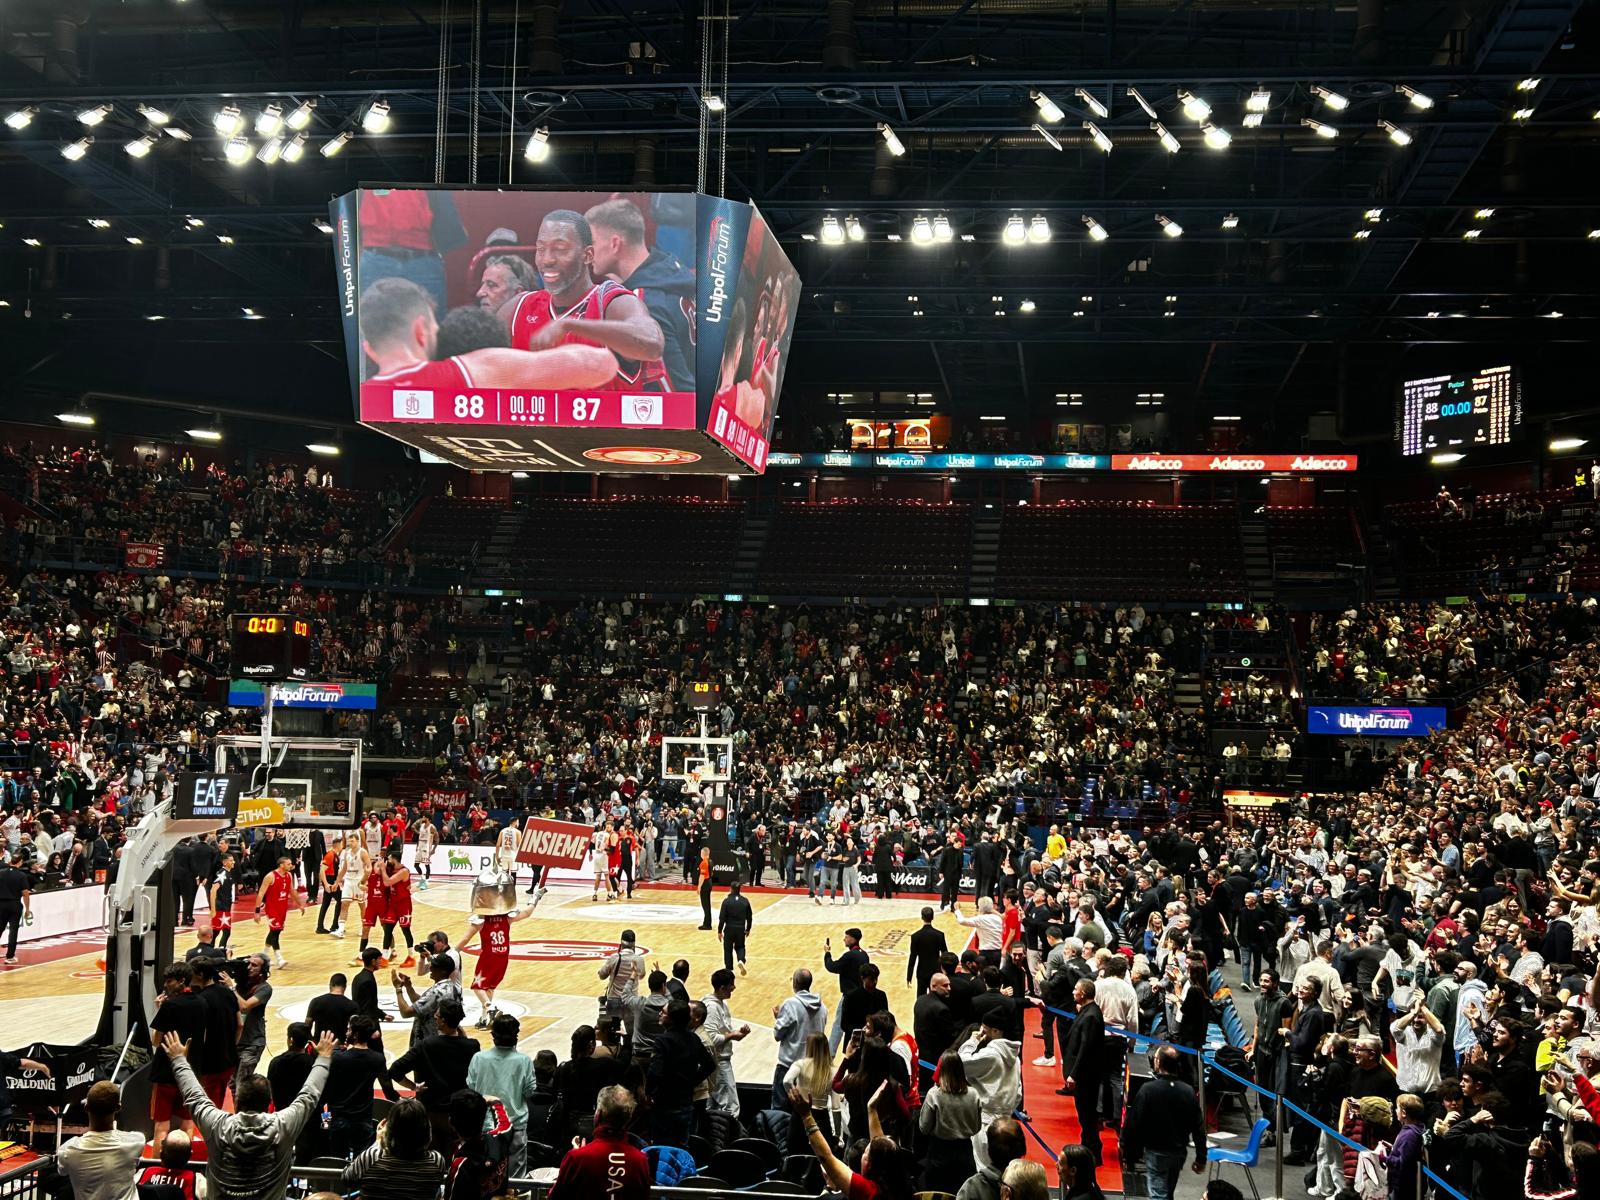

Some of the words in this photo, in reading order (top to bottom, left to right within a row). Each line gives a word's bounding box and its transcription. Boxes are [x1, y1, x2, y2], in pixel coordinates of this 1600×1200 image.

[342, 219, 355, 317] UnipolForum
[706, 223, 730, 323] UnipolForum
[455, 394, 484, 419] 88
[510, 395, 545, 414] 00.00
[1425, 402, 1438, 414] 88
[1441, 401, 1472, 416] 00.00
[1474, 395, 1488, 407] 87
[572, 397, 601, 421] 87
[766, 455, 801, 465] polForum
[825, 454, 851, 465] Unipol
[876, 456, 925, 466] UnipolForum
[949, 454, 975, 466] Unipol
[994, 457, 1043, 467] UnipolForum
[1068, 456, 1096, 468] Unipol
[1128, 456, 1183, 470] Adecco
[1209, 456, 1265, 470] Adecco
[1291, 456, 1347, 470] Adecco
[1339, 713, 1409, 733] UnipolForum
[193, 778, 229, 806] EA7
[235, 806, 272, 823] ETIHAD
[520, 828, 589, 860] INSIEME
[5, 1075, 56, 1091] SPALDING
[66, 1067, 95, 1090] SPALDING
